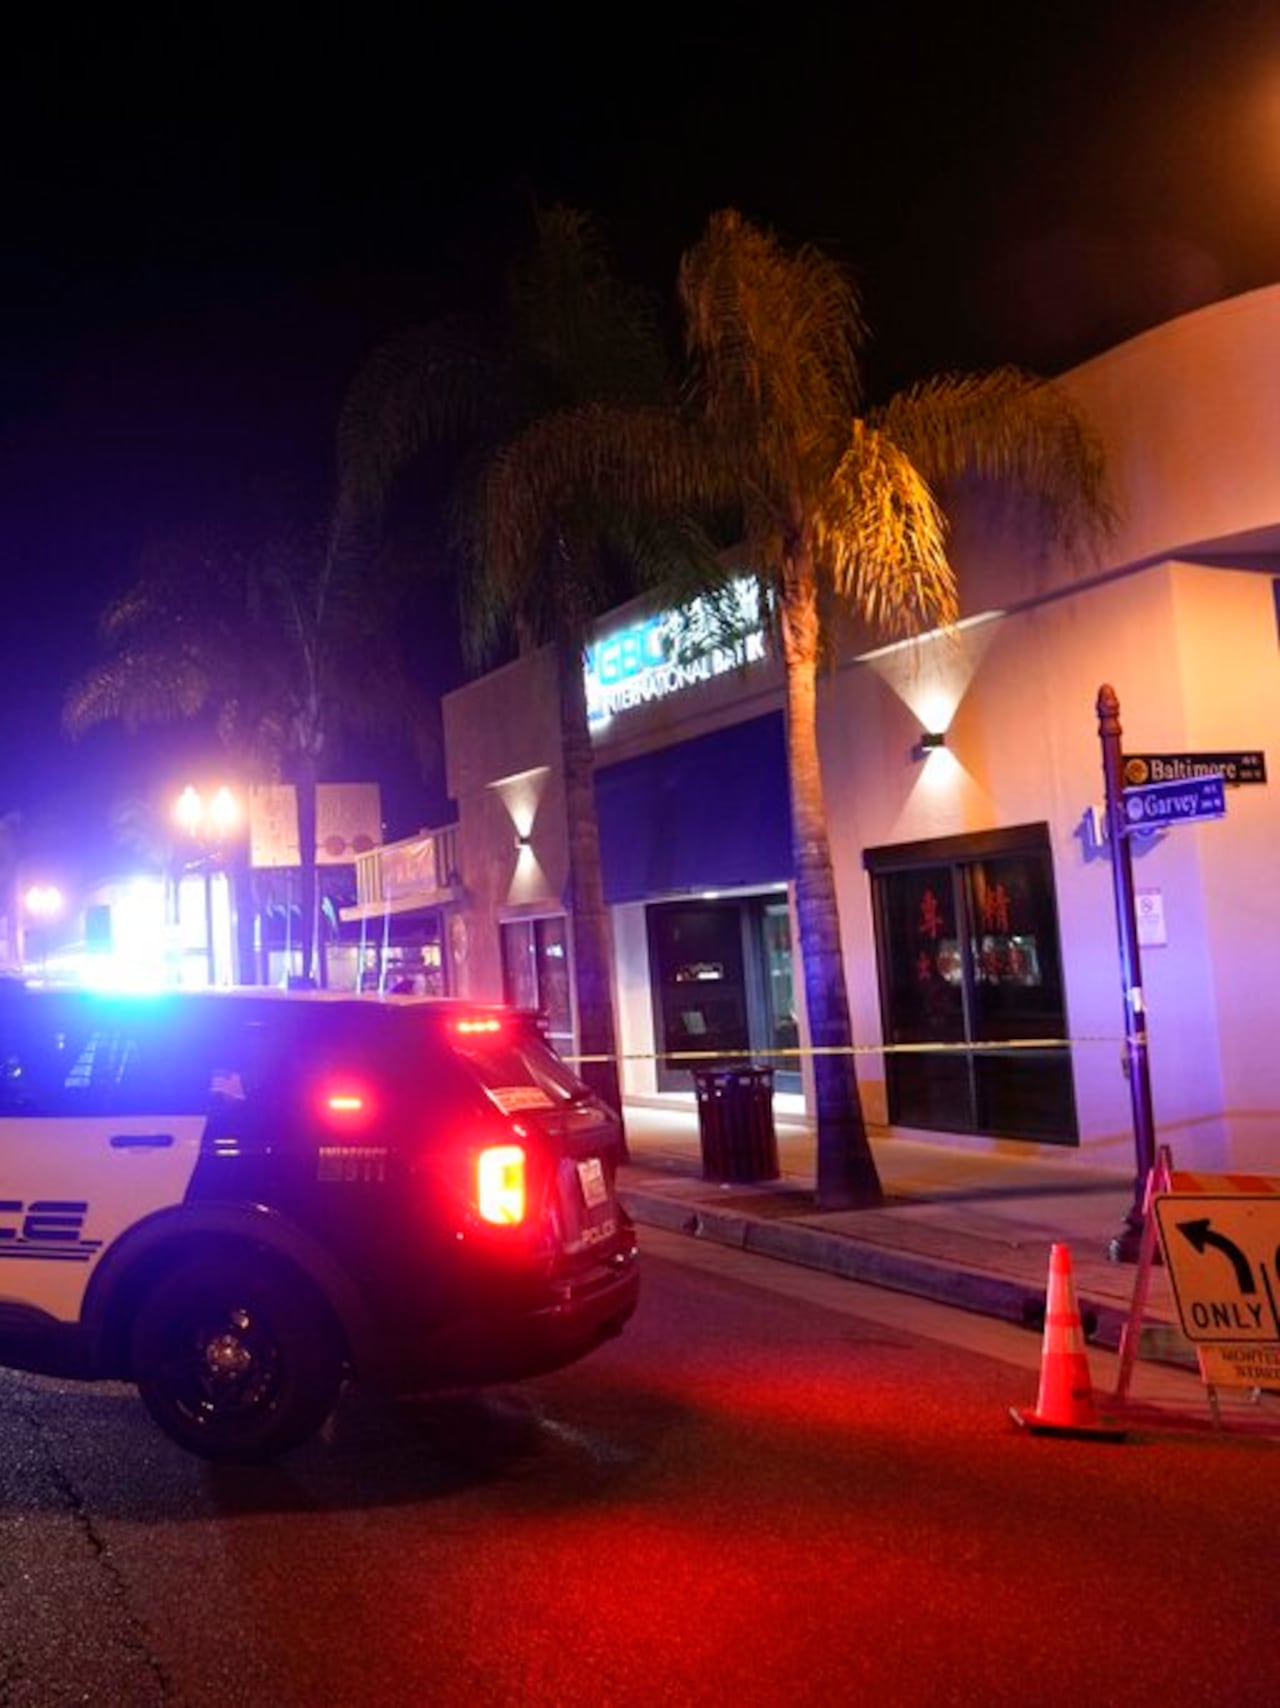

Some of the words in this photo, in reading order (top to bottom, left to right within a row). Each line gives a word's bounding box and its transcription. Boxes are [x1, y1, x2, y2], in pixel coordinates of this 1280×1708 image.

[1150, 757, 1237, 780] Baltimore
[1144, 792, 1200, 817] Garvey
[1191, 1301, 1262, 1329] ONLY
